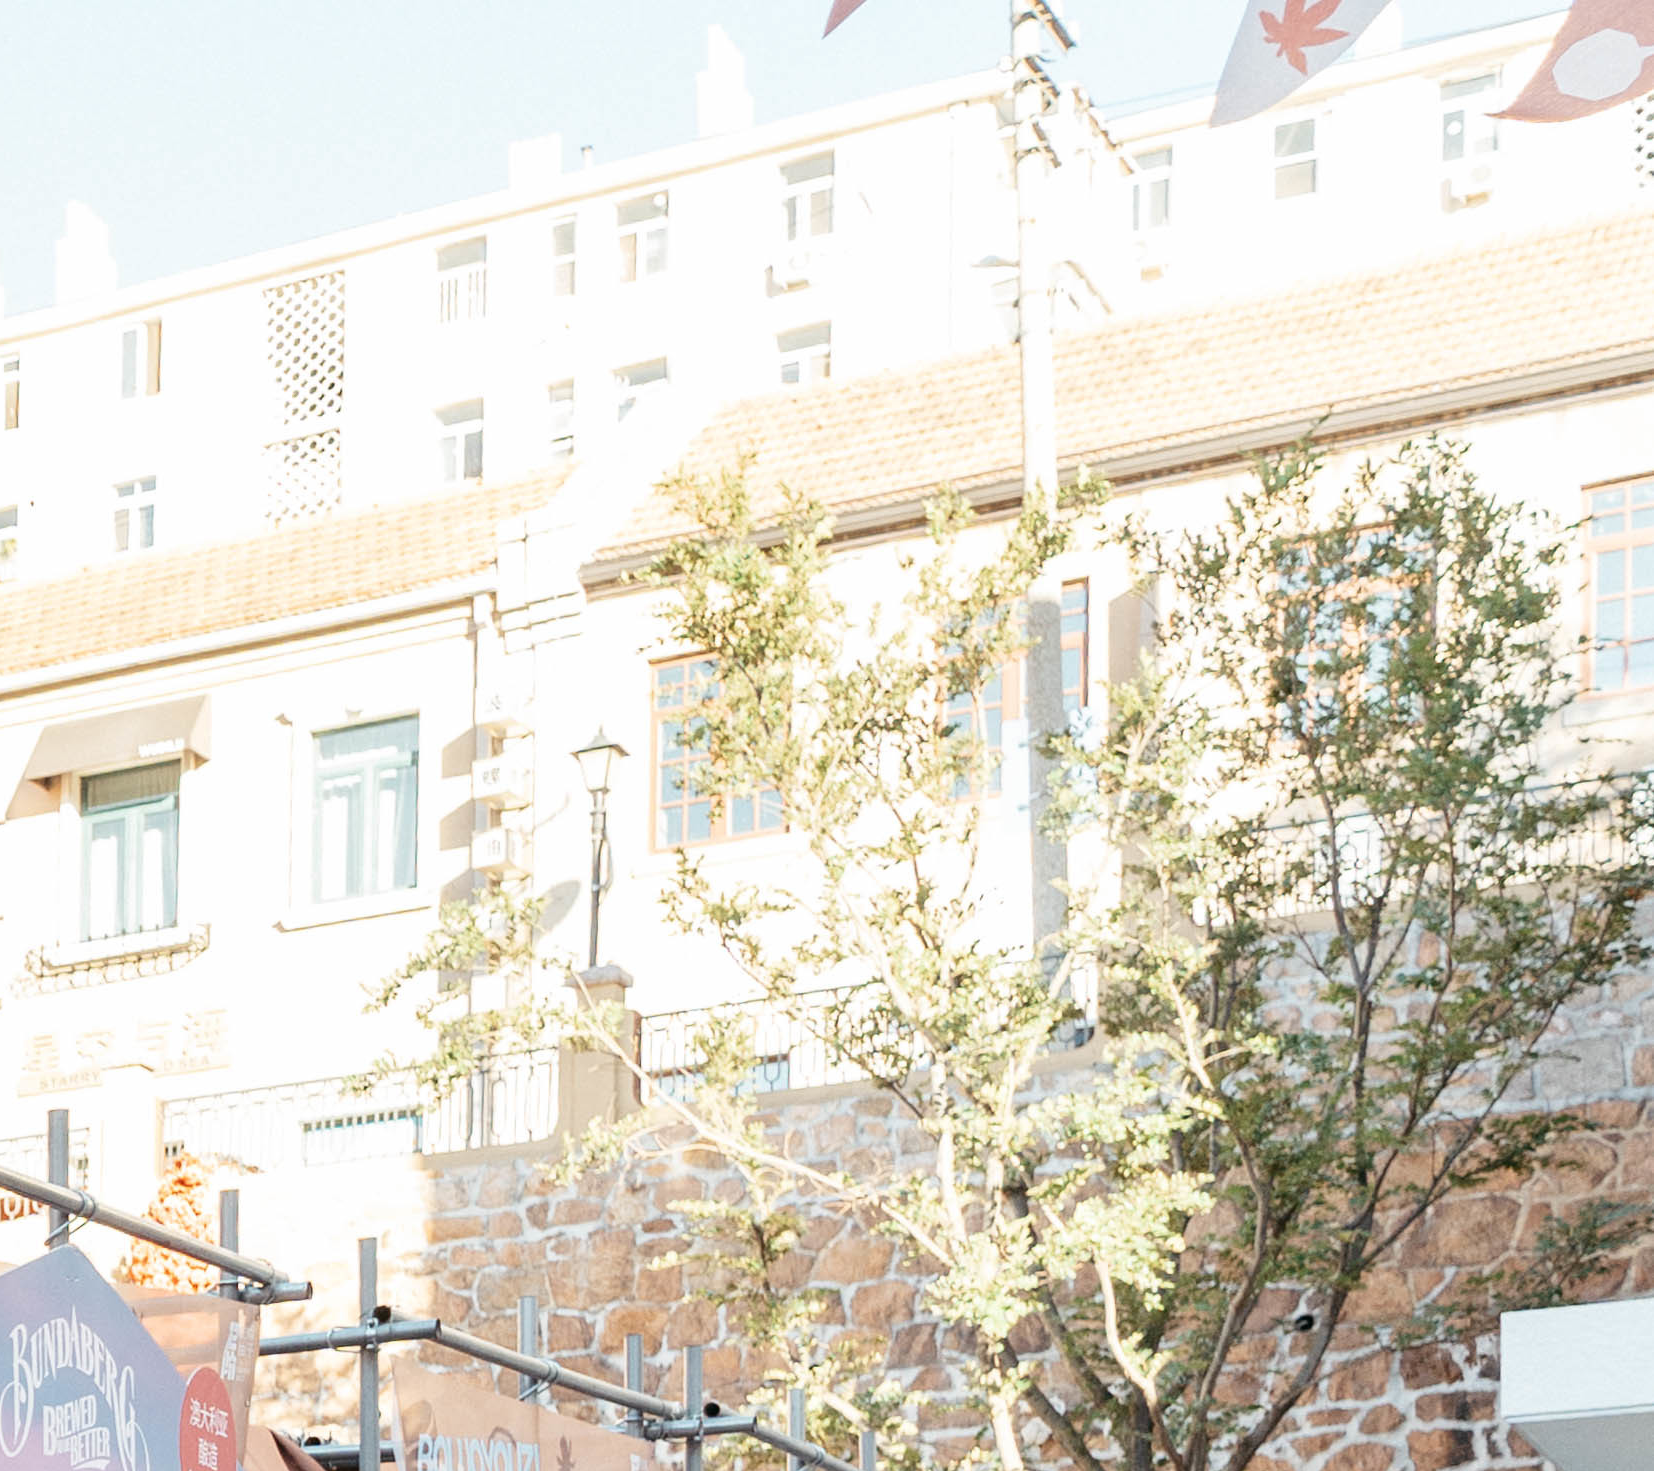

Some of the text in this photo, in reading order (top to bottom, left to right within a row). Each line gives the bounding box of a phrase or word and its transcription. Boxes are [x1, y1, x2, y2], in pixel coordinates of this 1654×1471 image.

[43, 1395, 97, 1456] BREWED
[189, 1399, 228, 1439] 澳大利亚
[70, 1427, 111, 1470] BETTER
[198, 1438, 218, 1471] 酿造
